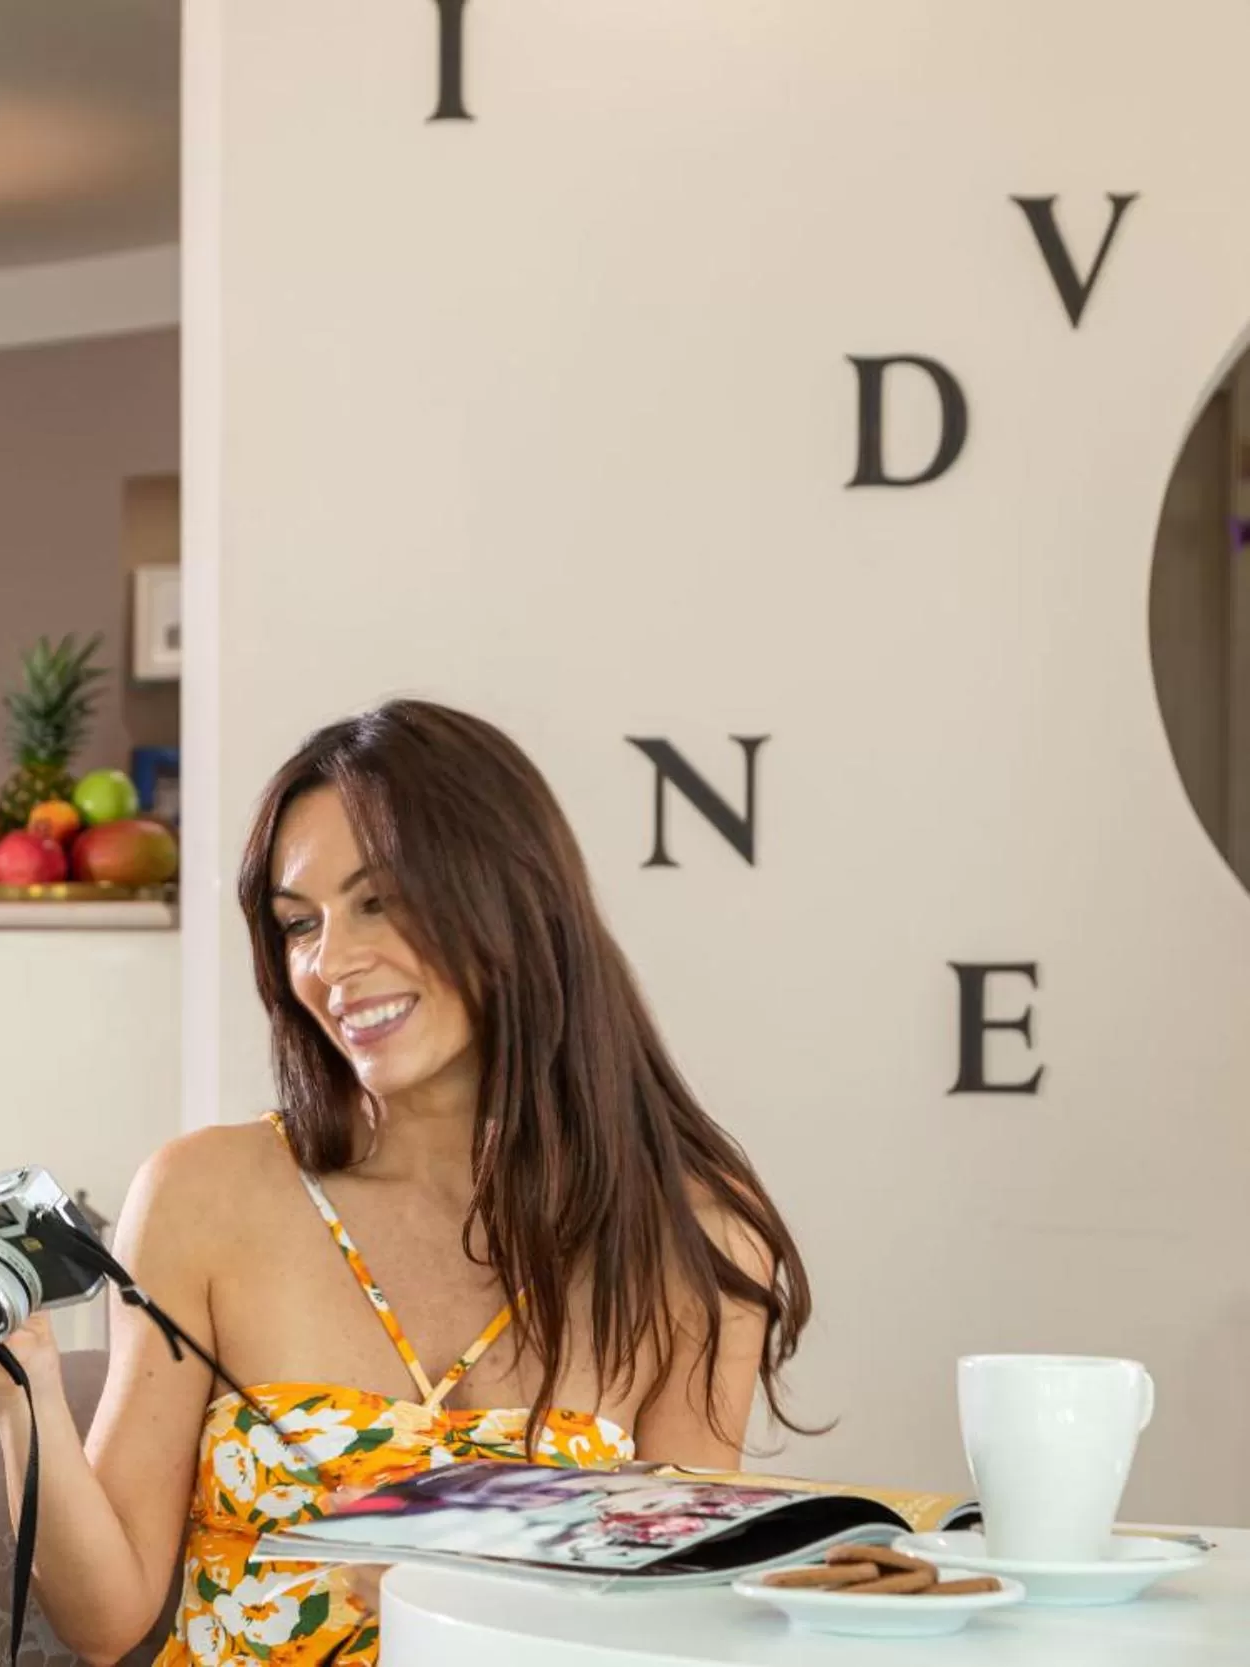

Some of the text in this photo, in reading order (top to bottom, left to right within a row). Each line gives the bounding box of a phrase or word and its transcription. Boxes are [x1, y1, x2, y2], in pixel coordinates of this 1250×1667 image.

[426, 0, 475, 123] I
[1010, 192, 1139, 330] V
[845, 353, 970, 489] D
[624, 735, 770, 868] N
[947, 961, 1045, 1096] E
